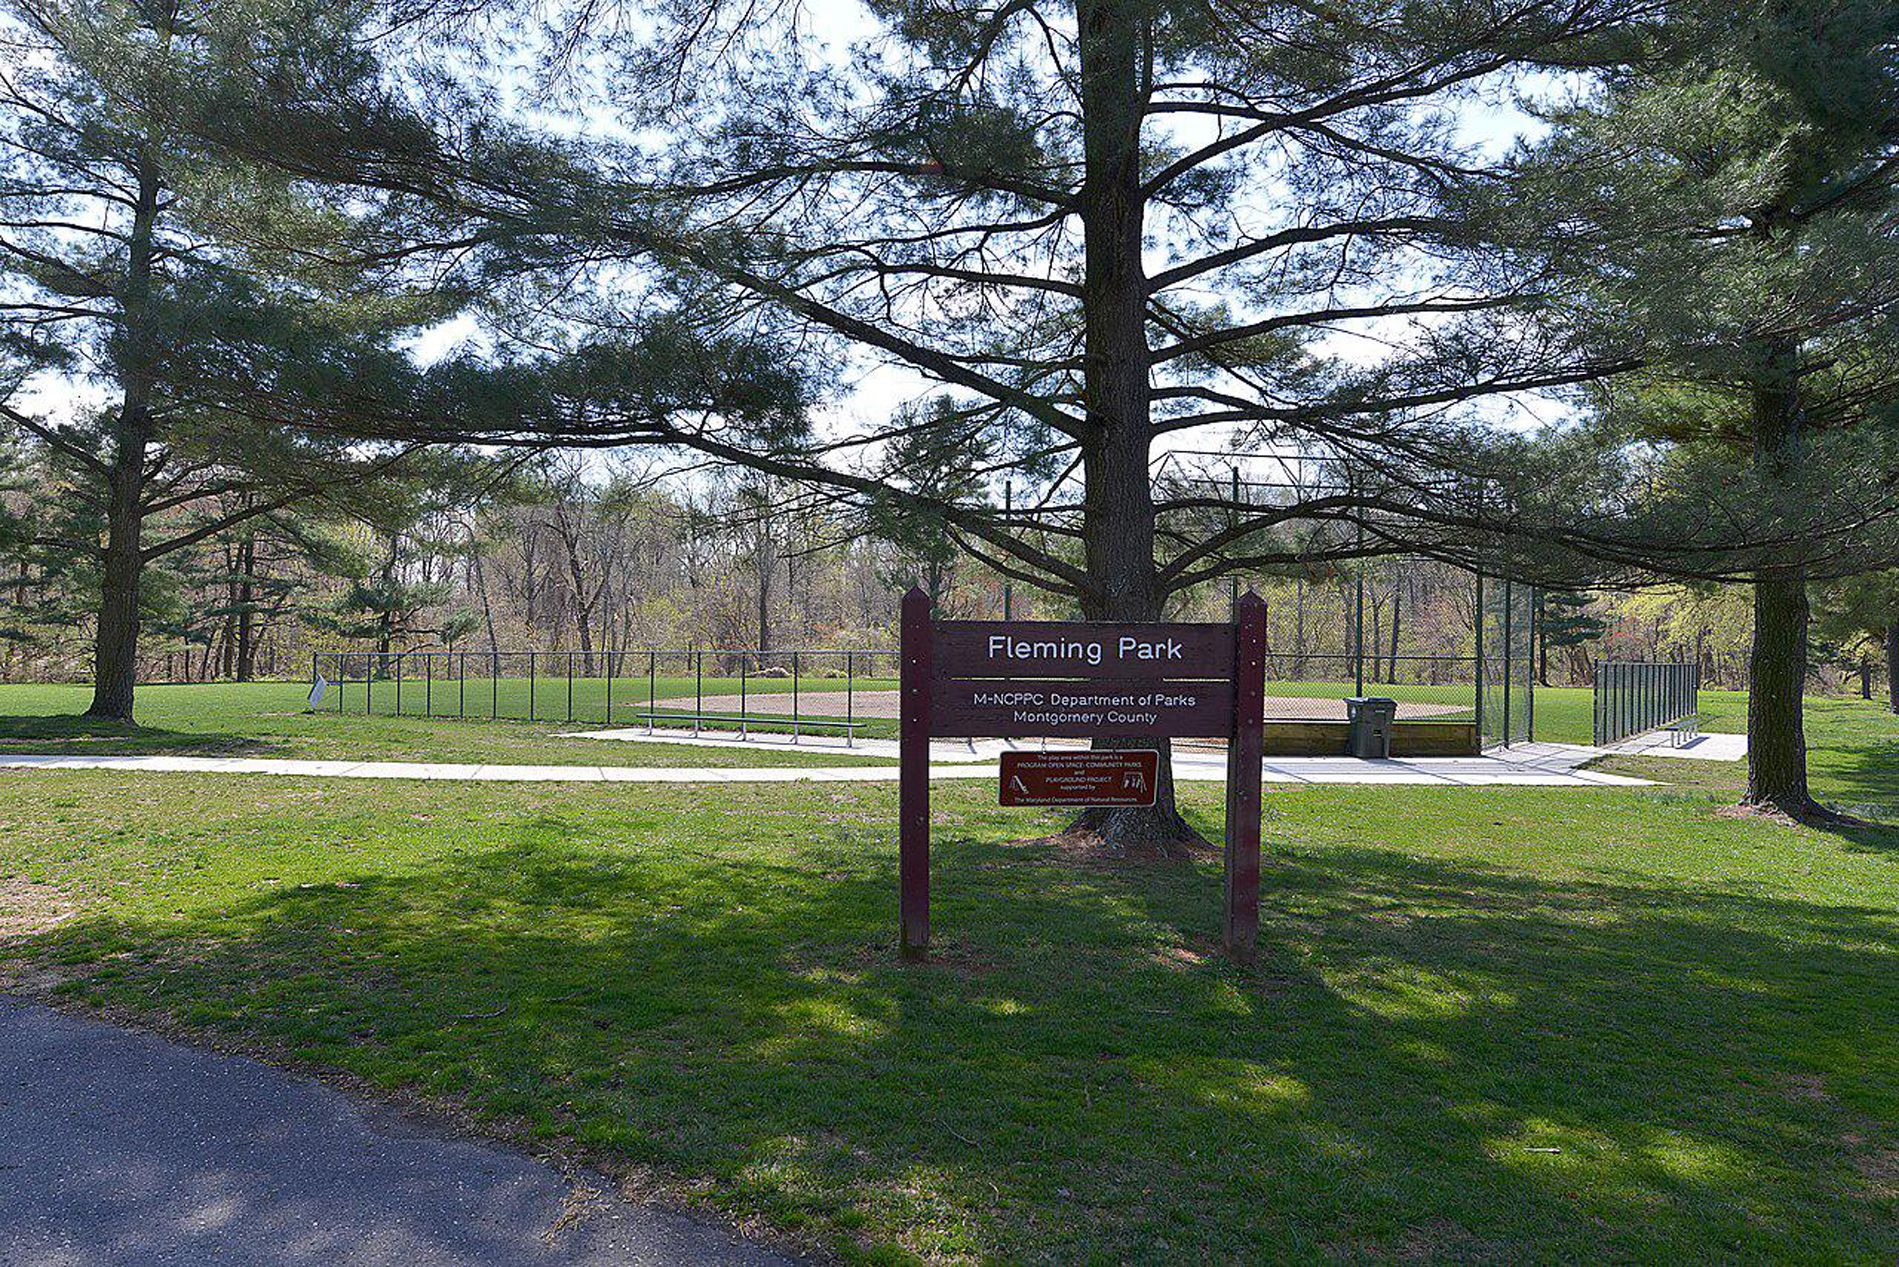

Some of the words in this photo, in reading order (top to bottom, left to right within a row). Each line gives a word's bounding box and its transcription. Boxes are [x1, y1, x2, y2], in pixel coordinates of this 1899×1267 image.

[989, 635, 1102, 665] Fleming
[1118, 637, 1183, 660] Park
[973, 693, 1044, 705] M-NCPPC
[1051, 693, 1134, 708] Department
[1138, 693, 1153, 706] of
[1155, 693, 1196, 706] Parks
[1014, 710, 1104, 726] Montgomery
[1107, 710, 1157, 725] County
[1017, 761, 1047, 769] PROGRAM
[1048, 761, 1065, 769] OPEN
